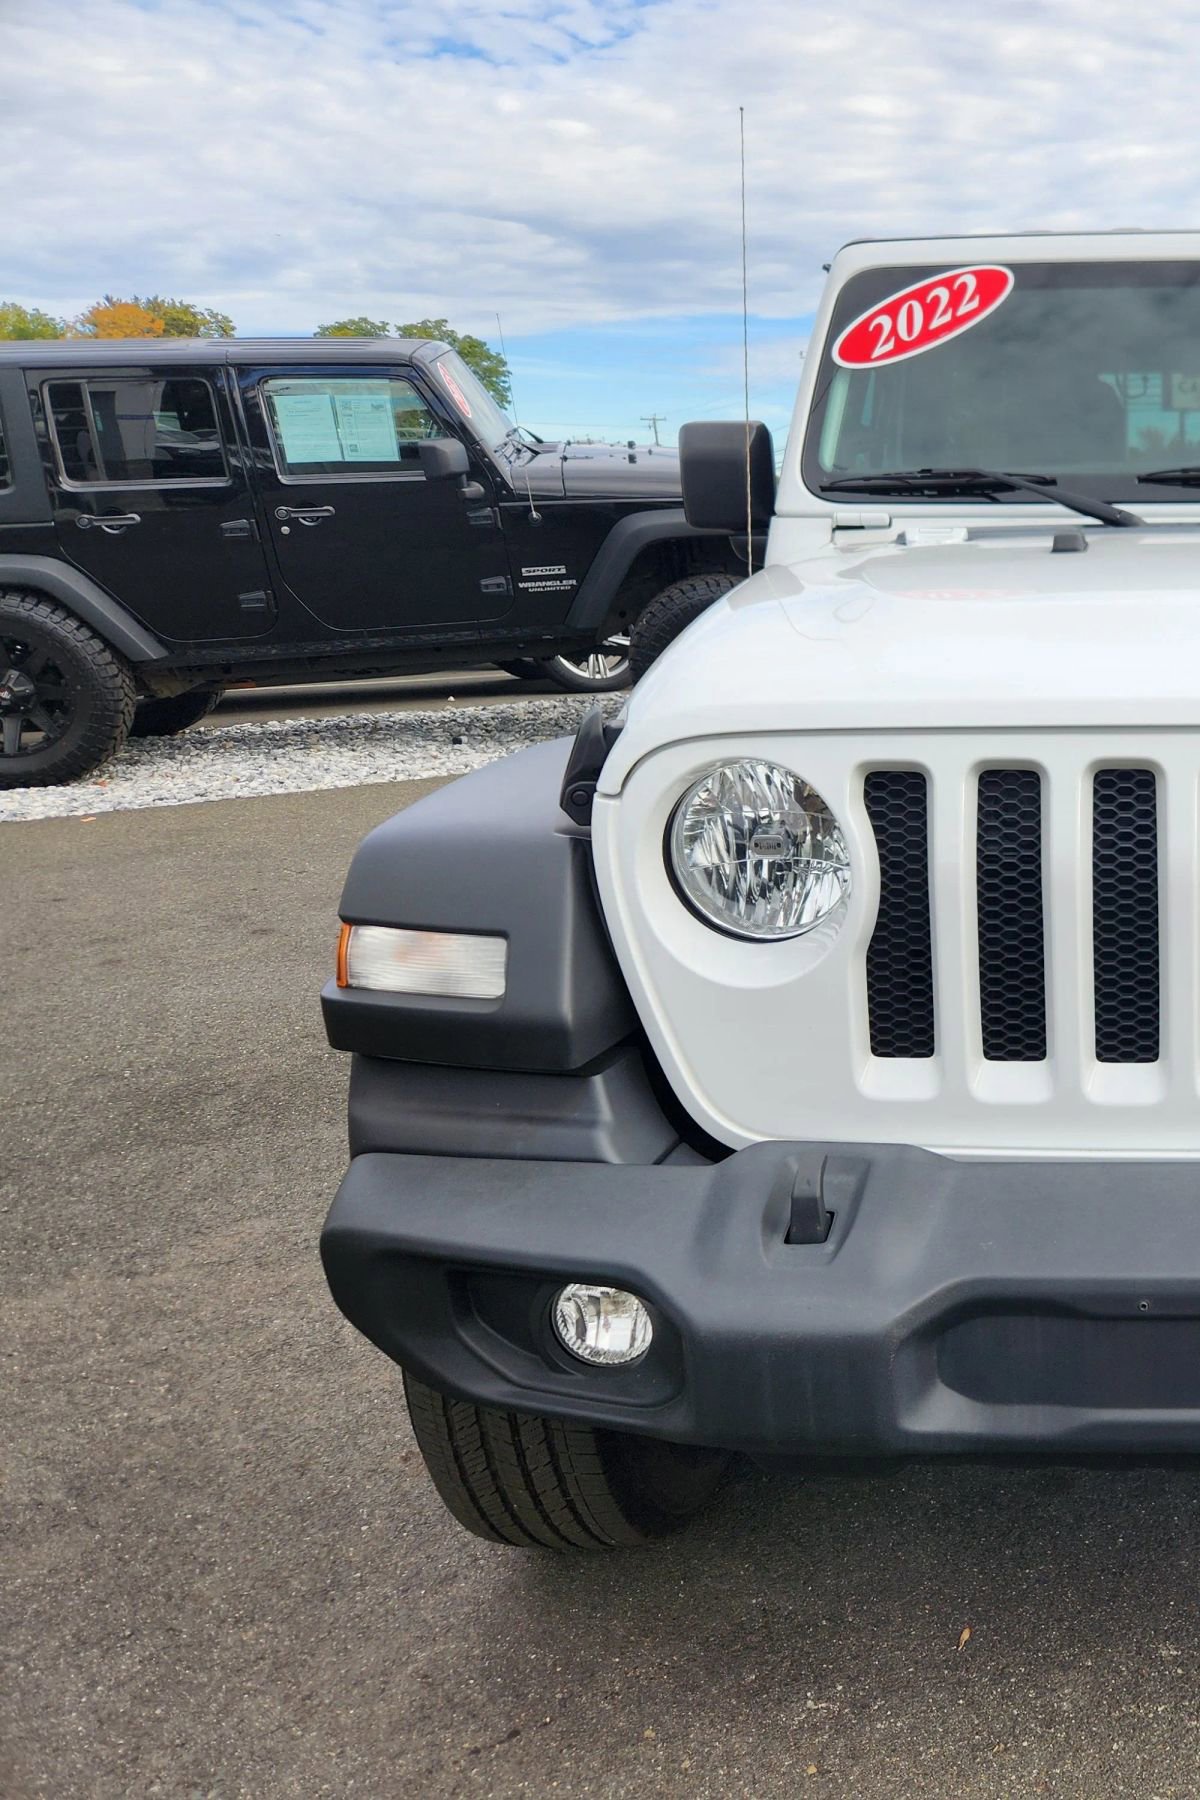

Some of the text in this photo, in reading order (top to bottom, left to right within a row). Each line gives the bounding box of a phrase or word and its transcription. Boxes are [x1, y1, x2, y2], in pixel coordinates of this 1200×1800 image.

[868, 273, 980, 360] 2022
[523, 567, 563, 575] SPORT
[518, 579, 578, 589] WRANGLER
